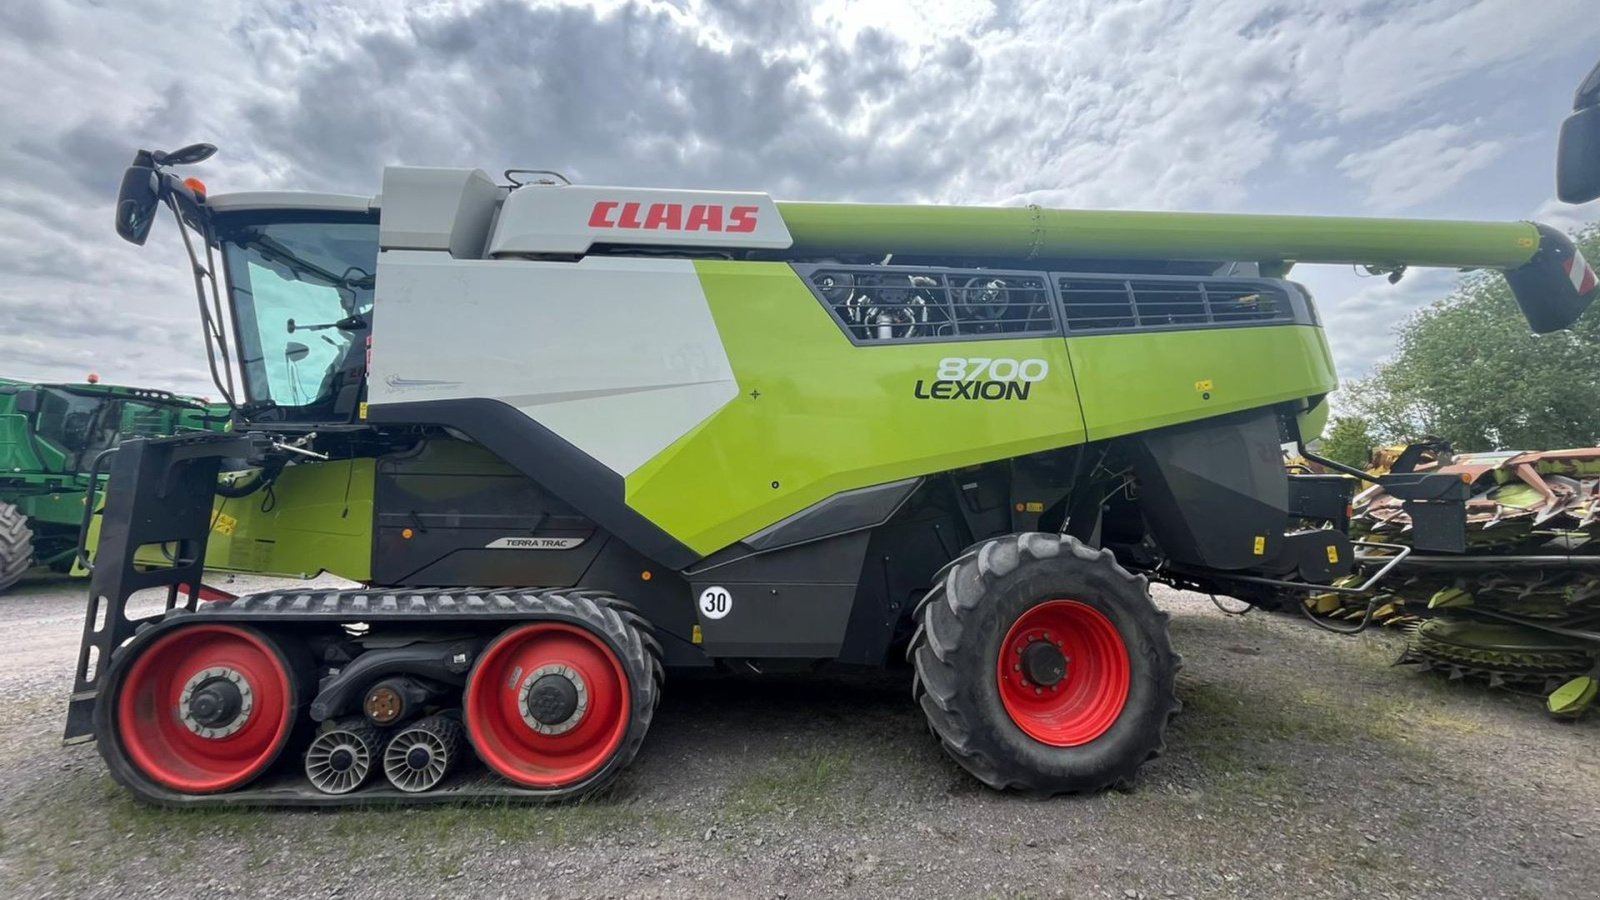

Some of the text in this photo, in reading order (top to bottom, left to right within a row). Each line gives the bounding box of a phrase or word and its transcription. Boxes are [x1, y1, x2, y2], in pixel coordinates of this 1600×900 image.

[588, 201, 759, 233] CLAAS
[937, 357, 1049, 382] 8700
[914, 380, 1031, 400] LEXION
[506, 539, 568, 547] TERRA TRAC
[705, 592, 726, 613] 30
